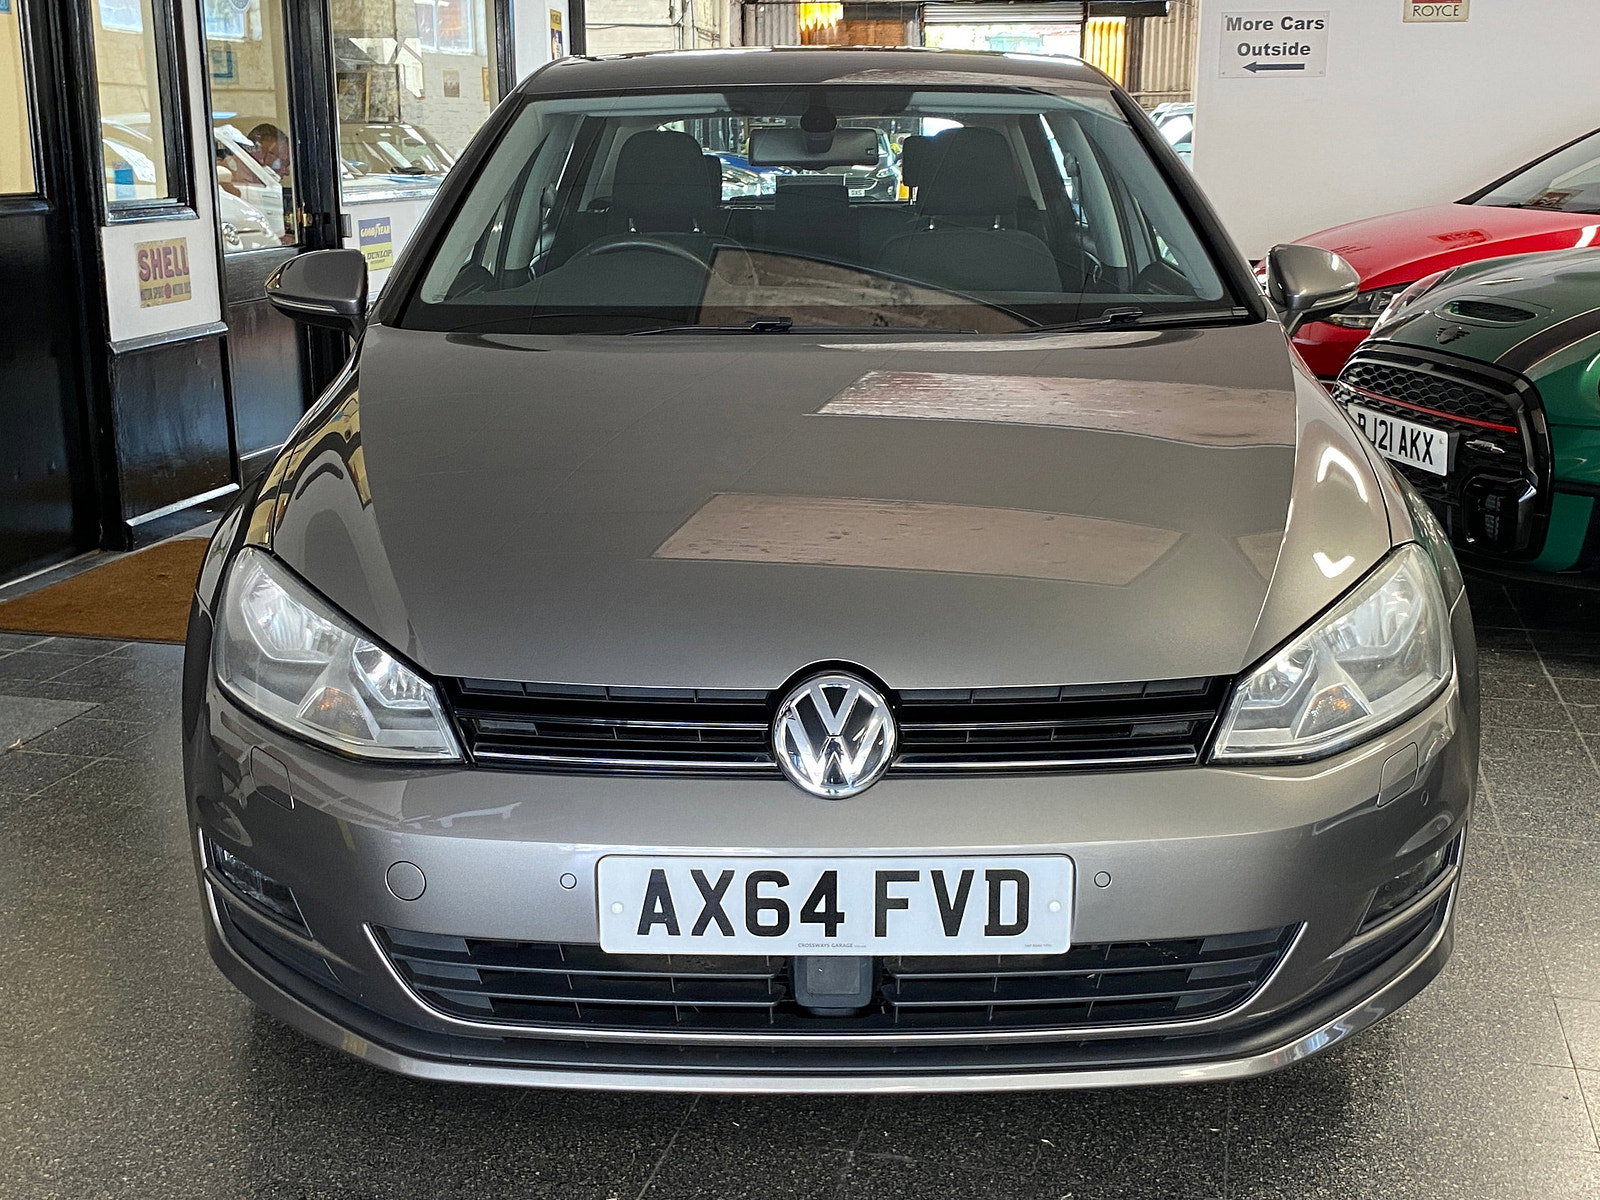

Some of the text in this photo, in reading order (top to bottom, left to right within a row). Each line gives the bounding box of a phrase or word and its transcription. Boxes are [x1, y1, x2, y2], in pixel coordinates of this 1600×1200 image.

[1226, 16, 1325, 31] More Cars
[1412, 4, 1460, 17] ROYCE
[1237, 42, 1311, 56] Outside
[138, 245, 189, 282] SHELL
[1398, 425, 1434, 466] AKX
[636, 868, 1030, 938] AX64 FVD
